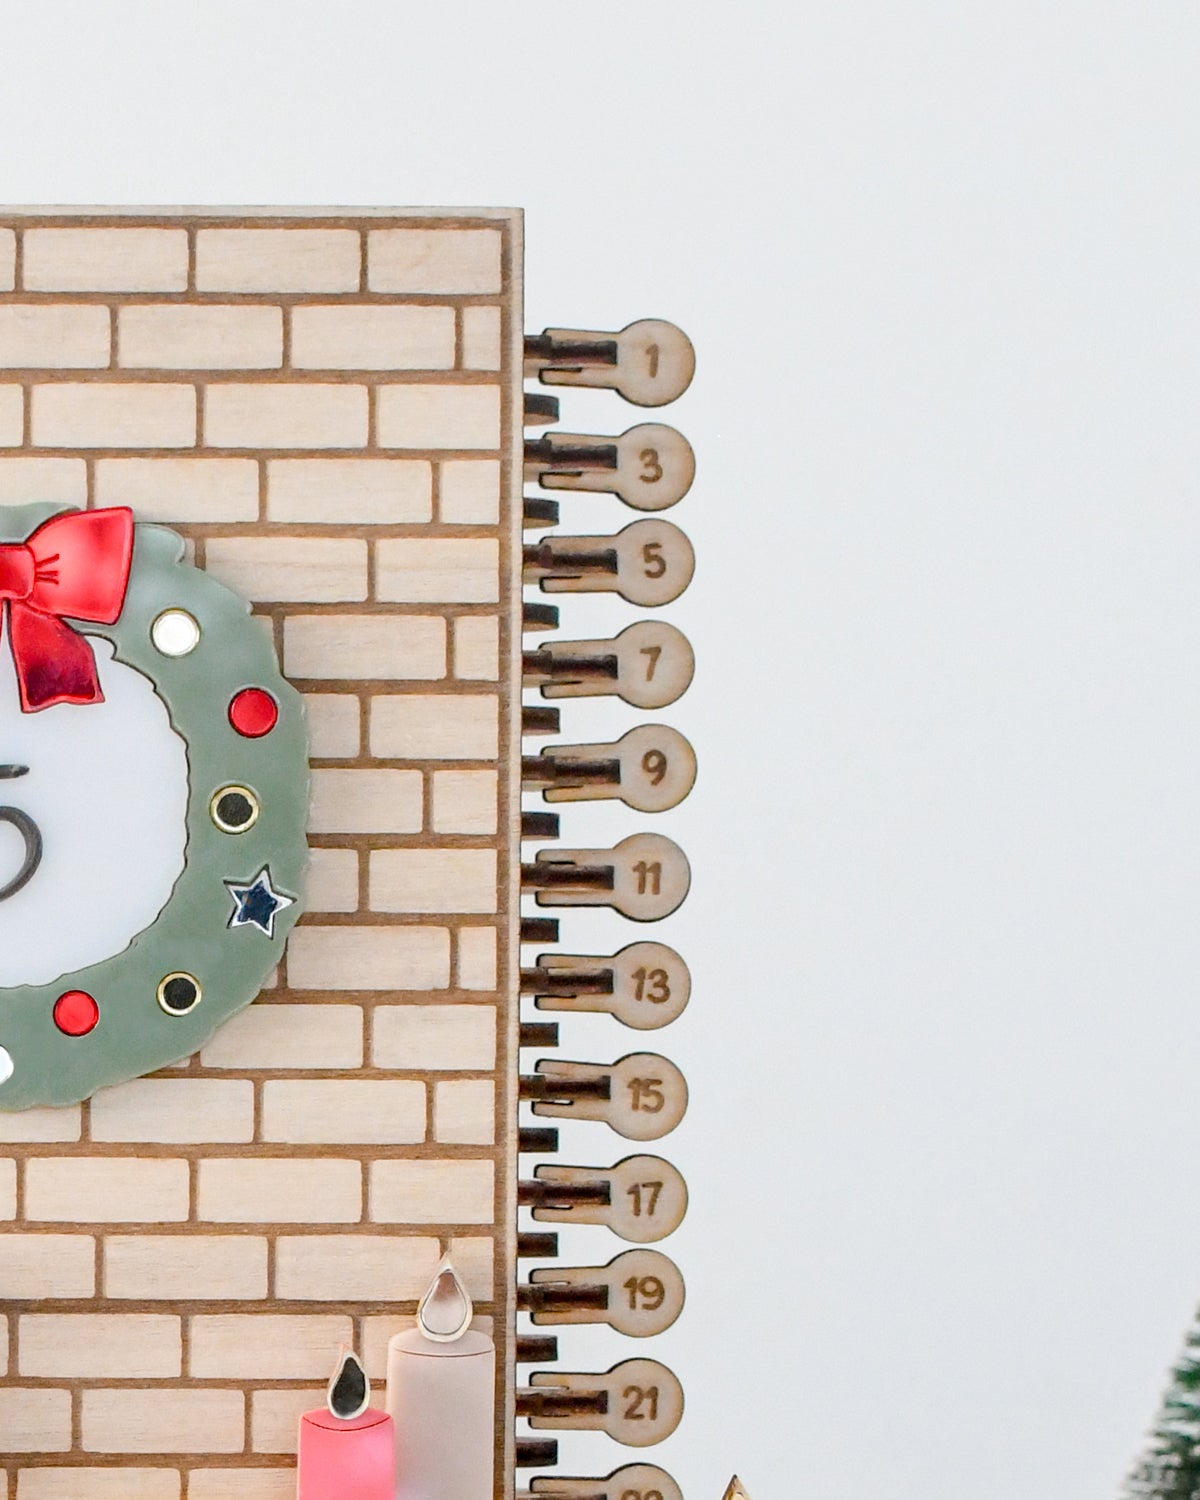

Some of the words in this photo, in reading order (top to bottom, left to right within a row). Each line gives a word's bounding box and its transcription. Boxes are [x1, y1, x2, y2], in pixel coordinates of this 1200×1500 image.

[646, 344, 659, 378] 1
[640, 448, 662, 483] 3
[643, 543, 666, 578] 5
[640, 646, 661, 681] 7
[643, 750, 667, 785] 9
[633, 861, 661, 895] 11
[632, 967, 670, 1003] 13
[627, 1078, 664, 1113] 15
[627, 1181, 663, 1216] 17
[624, 1276, 665, 1310] 19
[623, 1386, 658, 1420] 21
